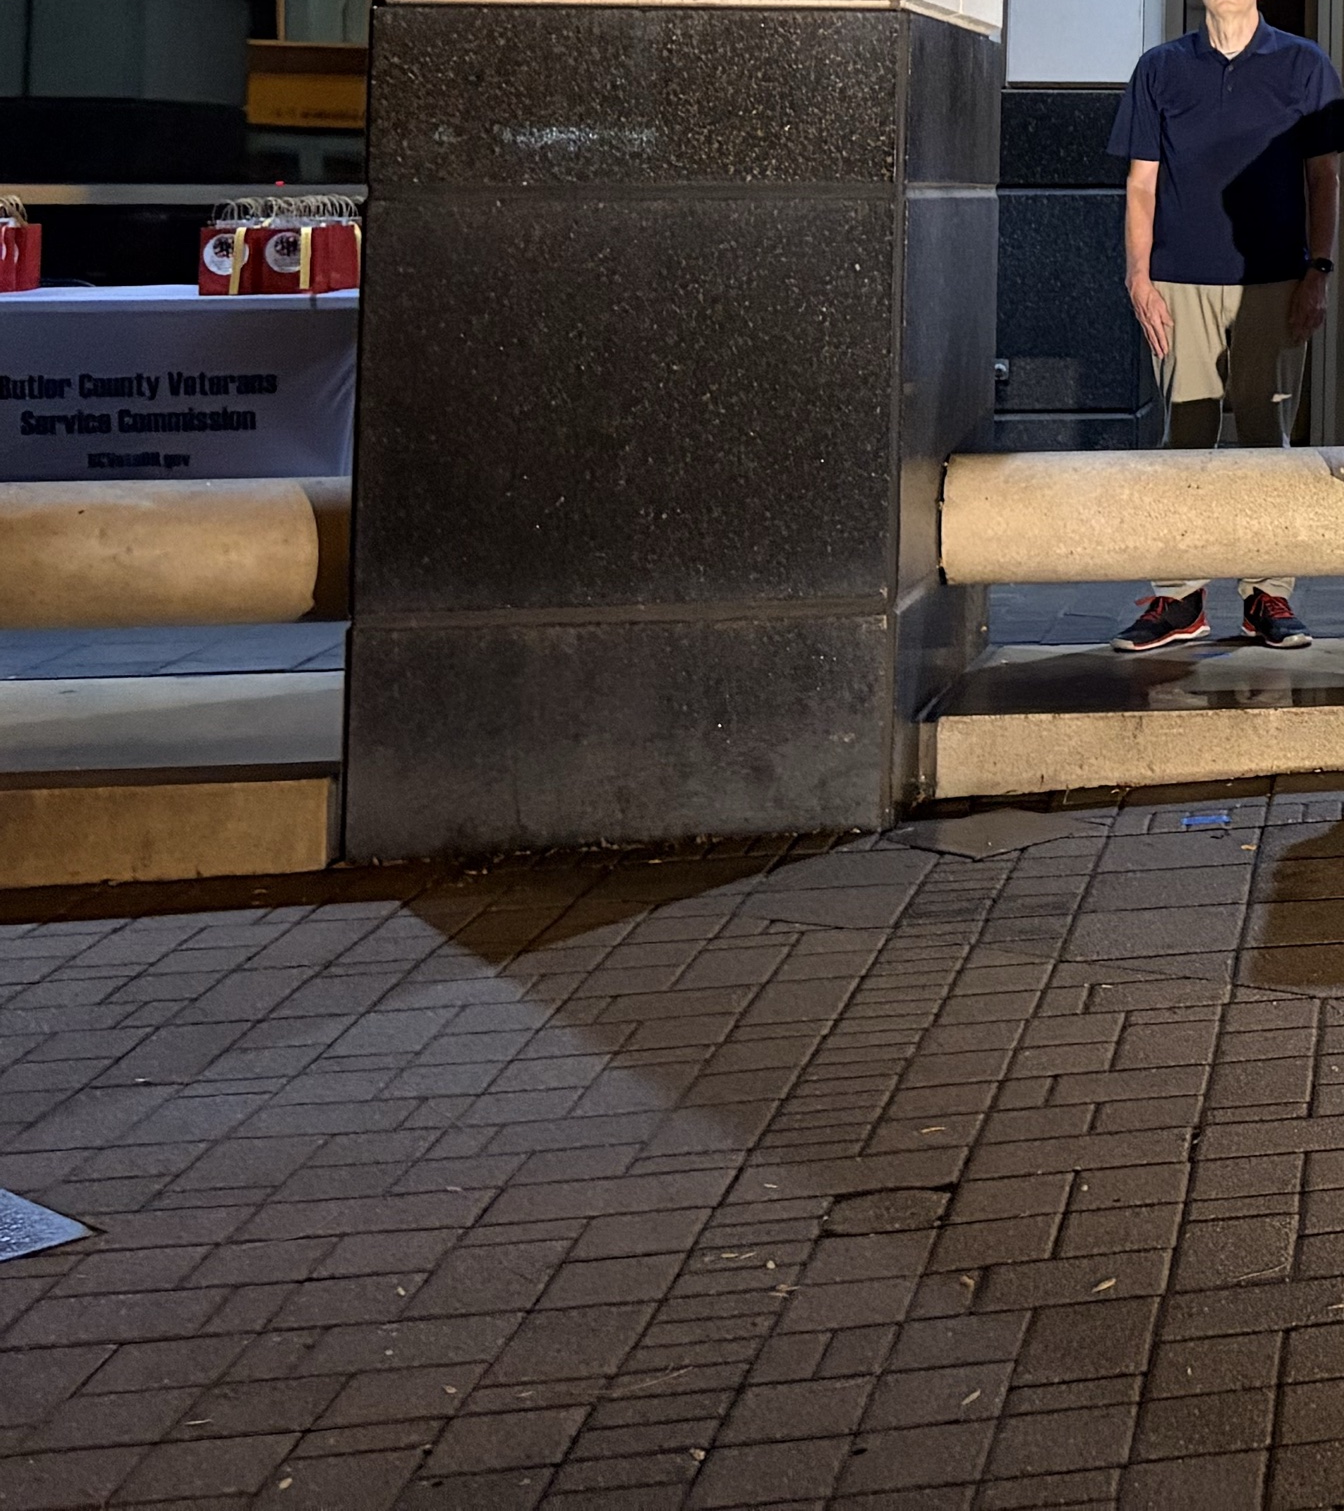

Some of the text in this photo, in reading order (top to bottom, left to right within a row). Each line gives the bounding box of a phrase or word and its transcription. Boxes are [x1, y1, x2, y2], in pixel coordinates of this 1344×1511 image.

[0, 371, 278, 401] Butler County Veterans
[20, 406, 256, 435] Service Commission
